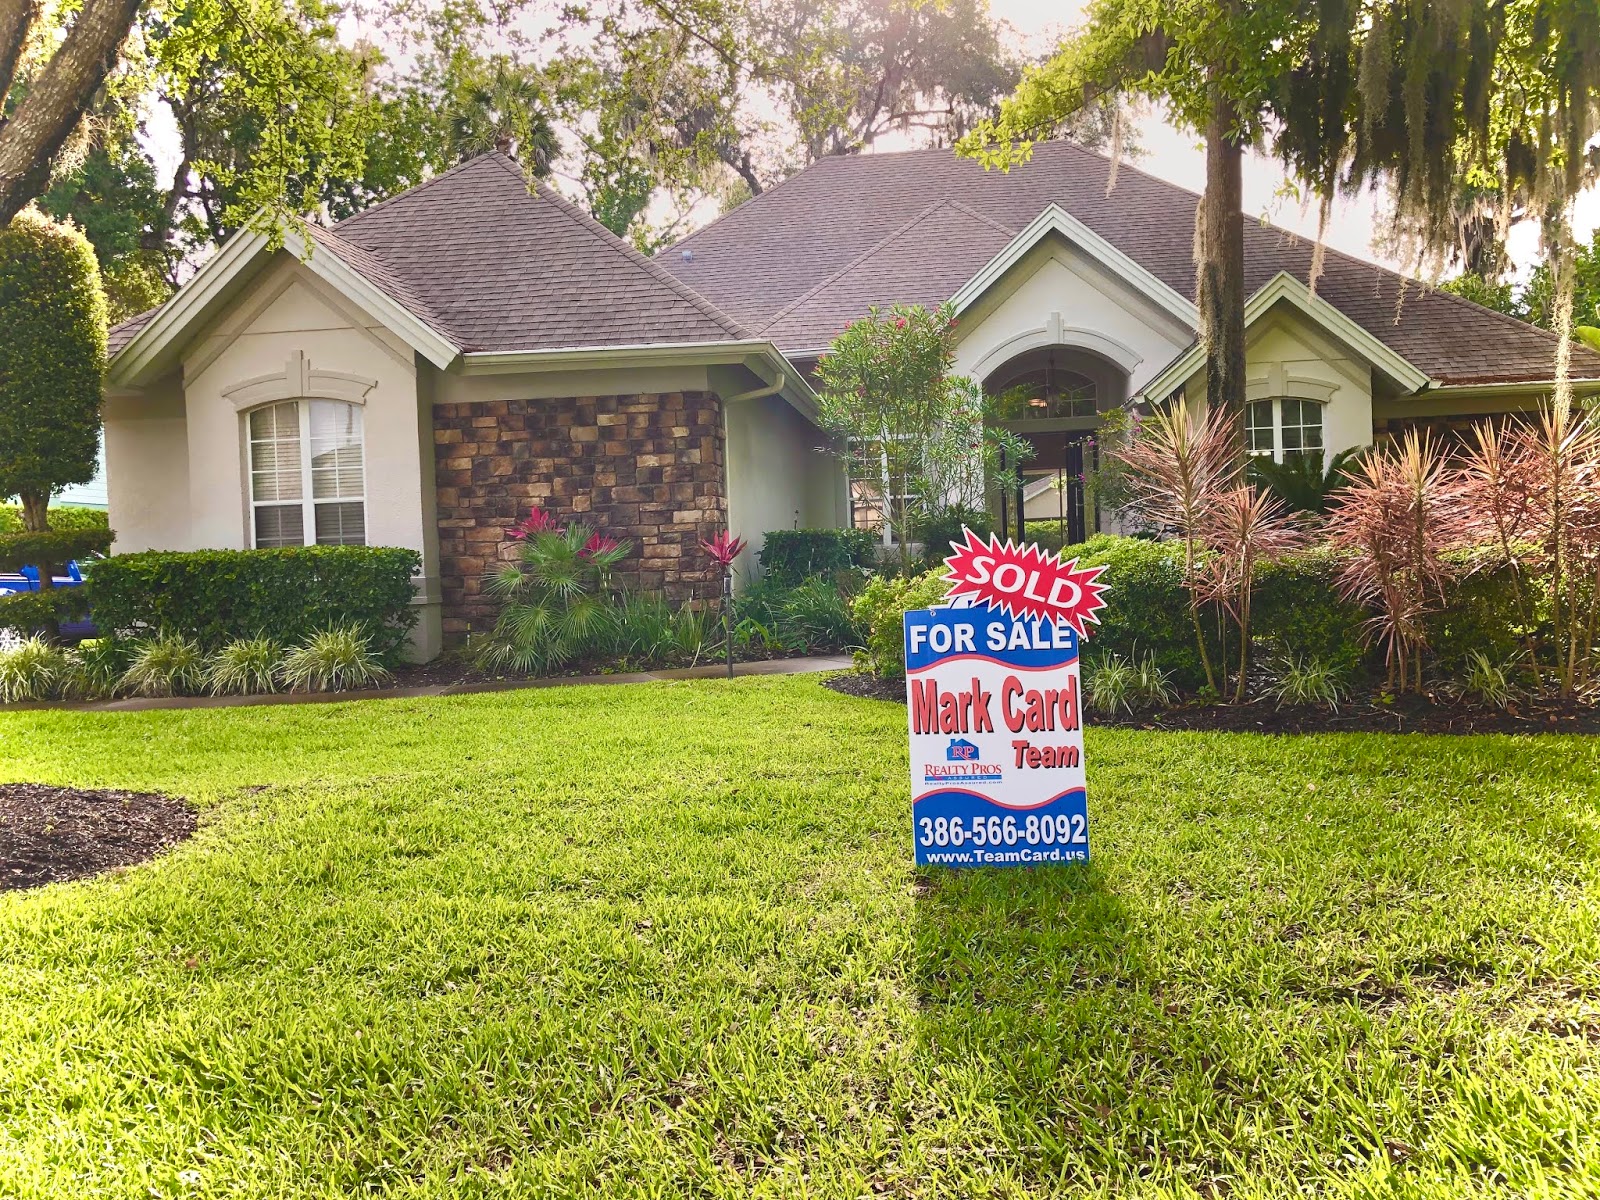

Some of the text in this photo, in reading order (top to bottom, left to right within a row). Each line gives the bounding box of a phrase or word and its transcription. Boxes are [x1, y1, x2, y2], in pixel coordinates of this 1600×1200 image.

[965, 556, 1083, 609] SOLD
[910, 620, 1073, 654] FOR SALE
[911, 674, 1080, 735] Mark Card
[971, 763, 1002, 775] PROS
[1011, 740, 1080, 769] Team
[919, 813, 1087, 847] 386-566-8092
[926, 848, 1086, 863] www.TeamCard.us
